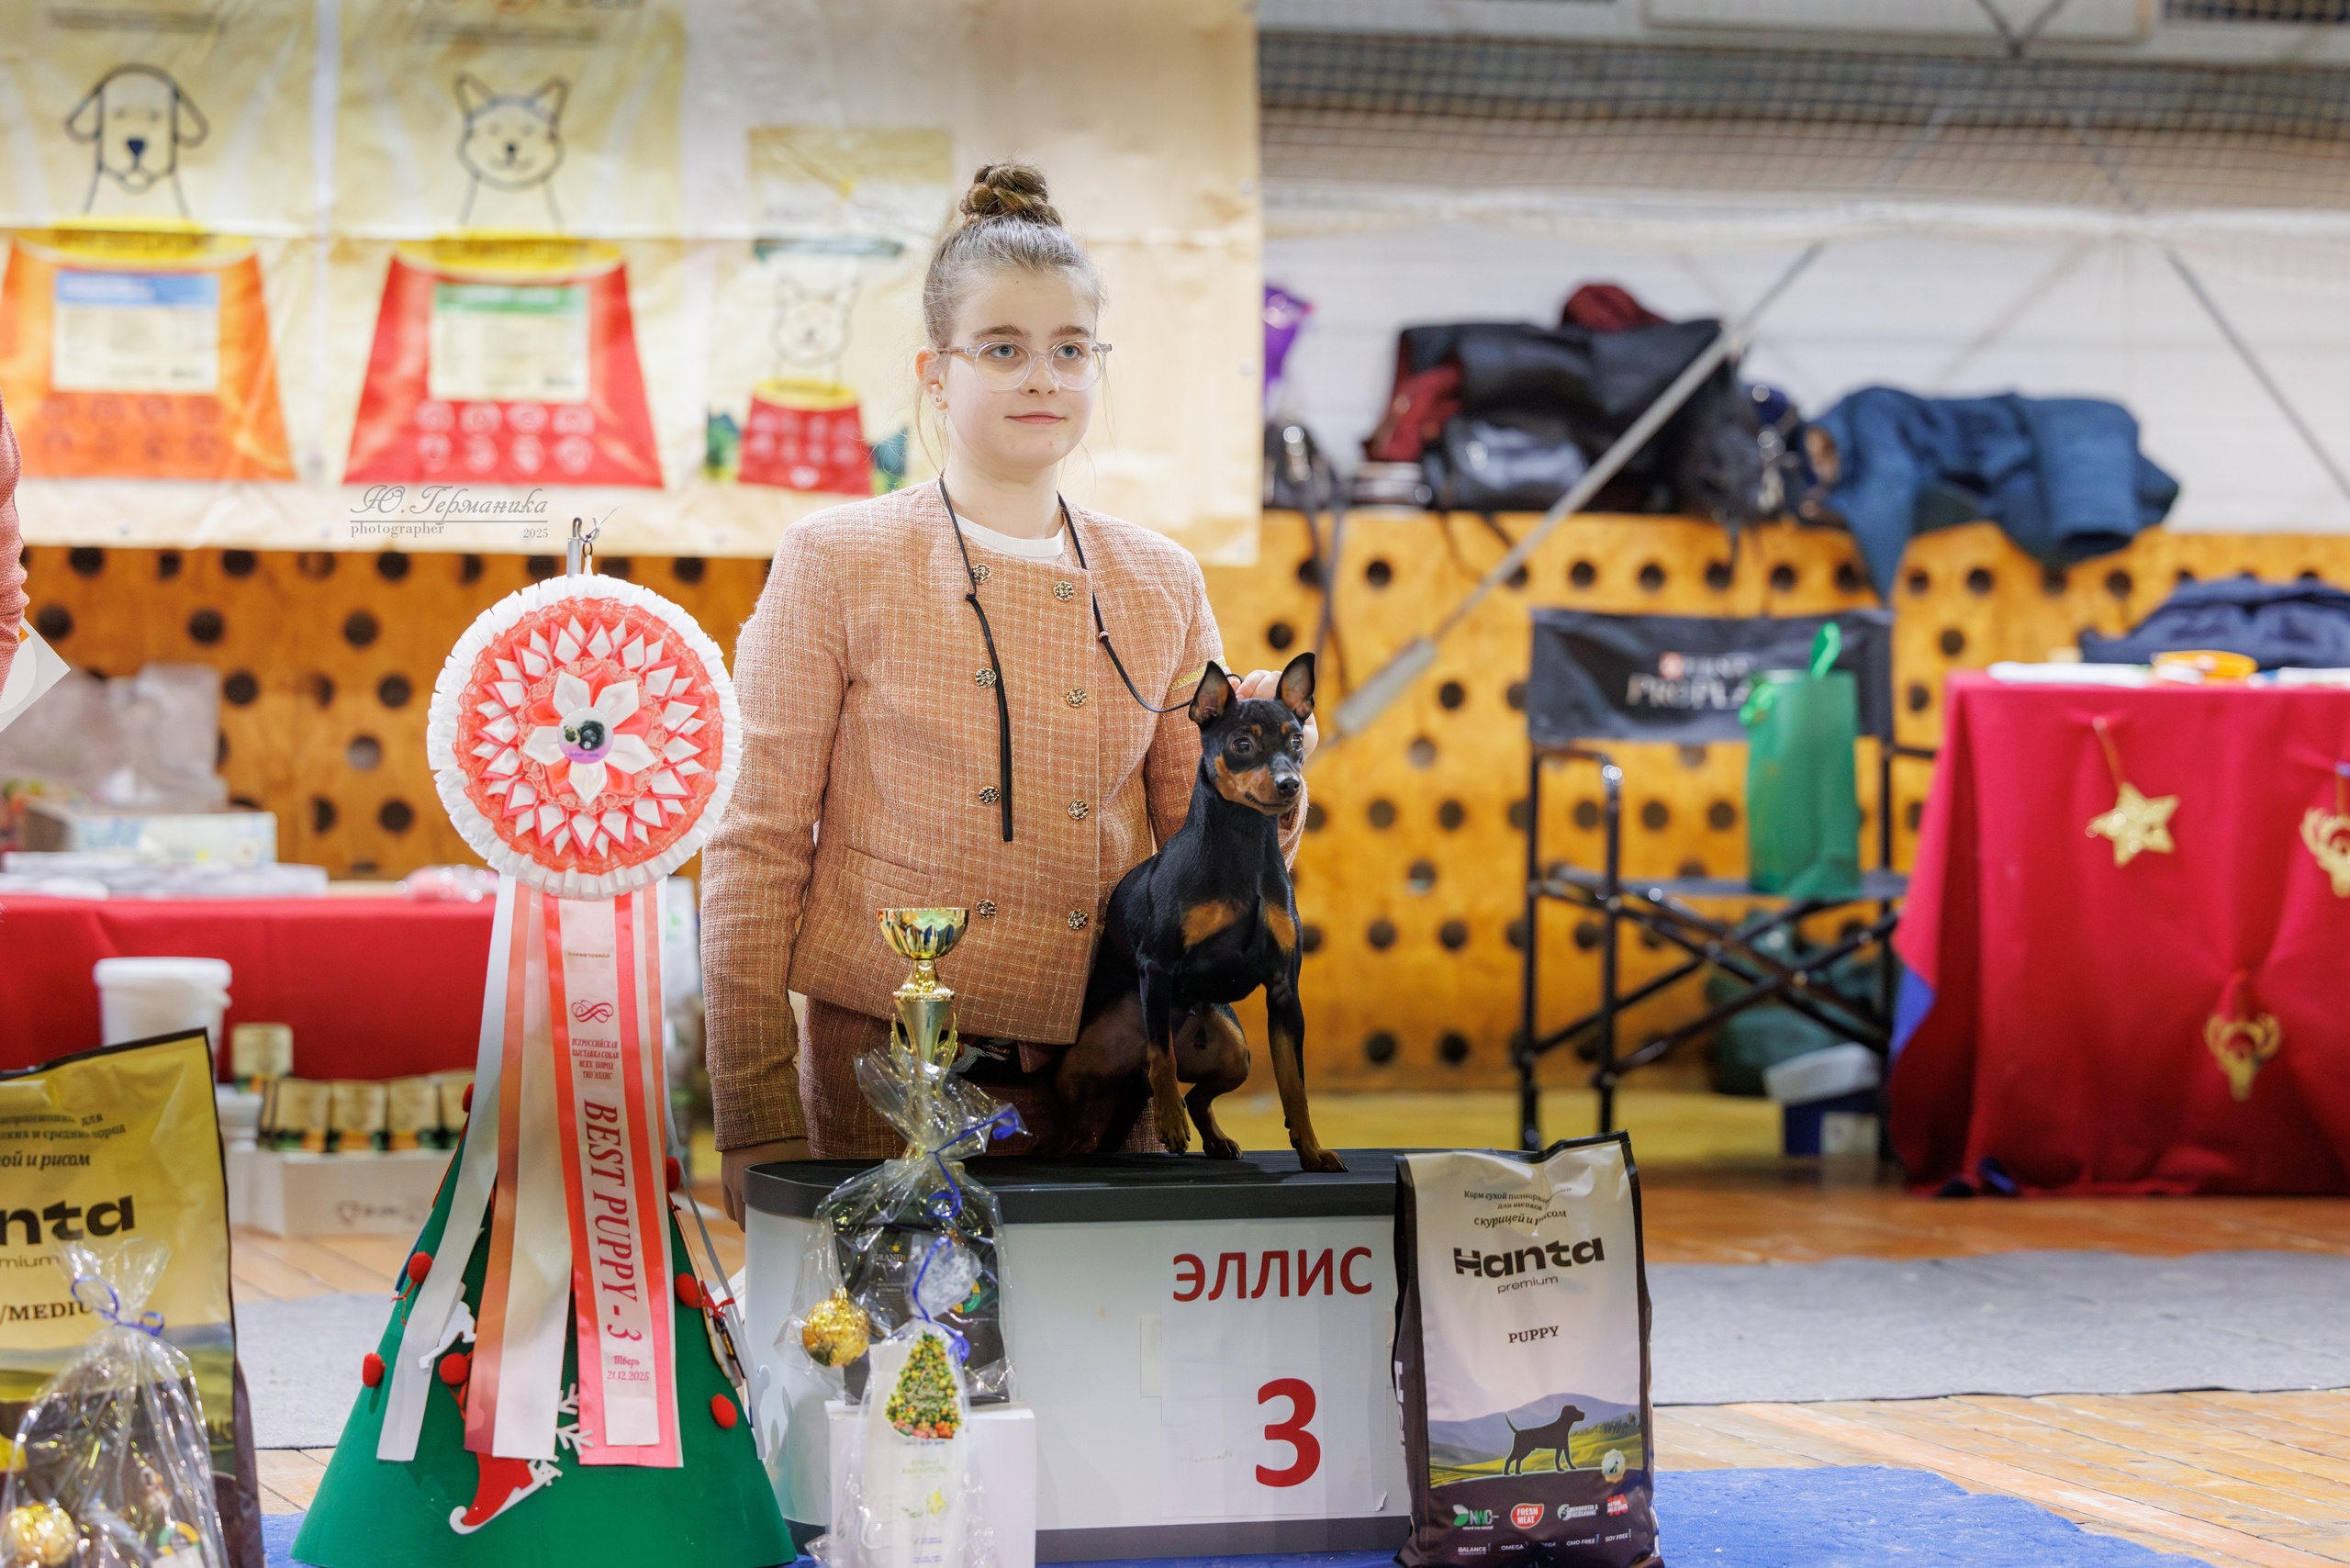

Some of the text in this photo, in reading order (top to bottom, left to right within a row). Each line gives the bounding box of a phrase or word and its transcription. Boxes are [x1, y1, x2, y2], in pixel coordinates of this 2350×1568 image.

[584, 1099, 627, 1188] BEST
[0, 1150, 90, 1170] ой и рисом
[1464, 1190, 1484, 1200] Корм
[1485, 1192, 1506, 1200] сухой
[1481, 1213, 1525, 1228] курицей
[593, 1190, 638, 1303] PUPPY
[1453, 1238, 1606, 1278] Hanta
[1173, 1247, 1372, 1302] ЭЛЛИС
[1497, 1274, 1559, 1294] premium
[607, 1323, 643, 1342] 3
[1508, 1325, 1560, 1344] PUPPY
[613, 1355, 641, 1370] Тверь
[607, 1370, 650, 1382] 21.12.2025
[1256, 1378, 1322, 1487] 3
[1516, 1507, 1539, 1516] FRESH
[1517, 1516, 1535, 1524] MEAT
